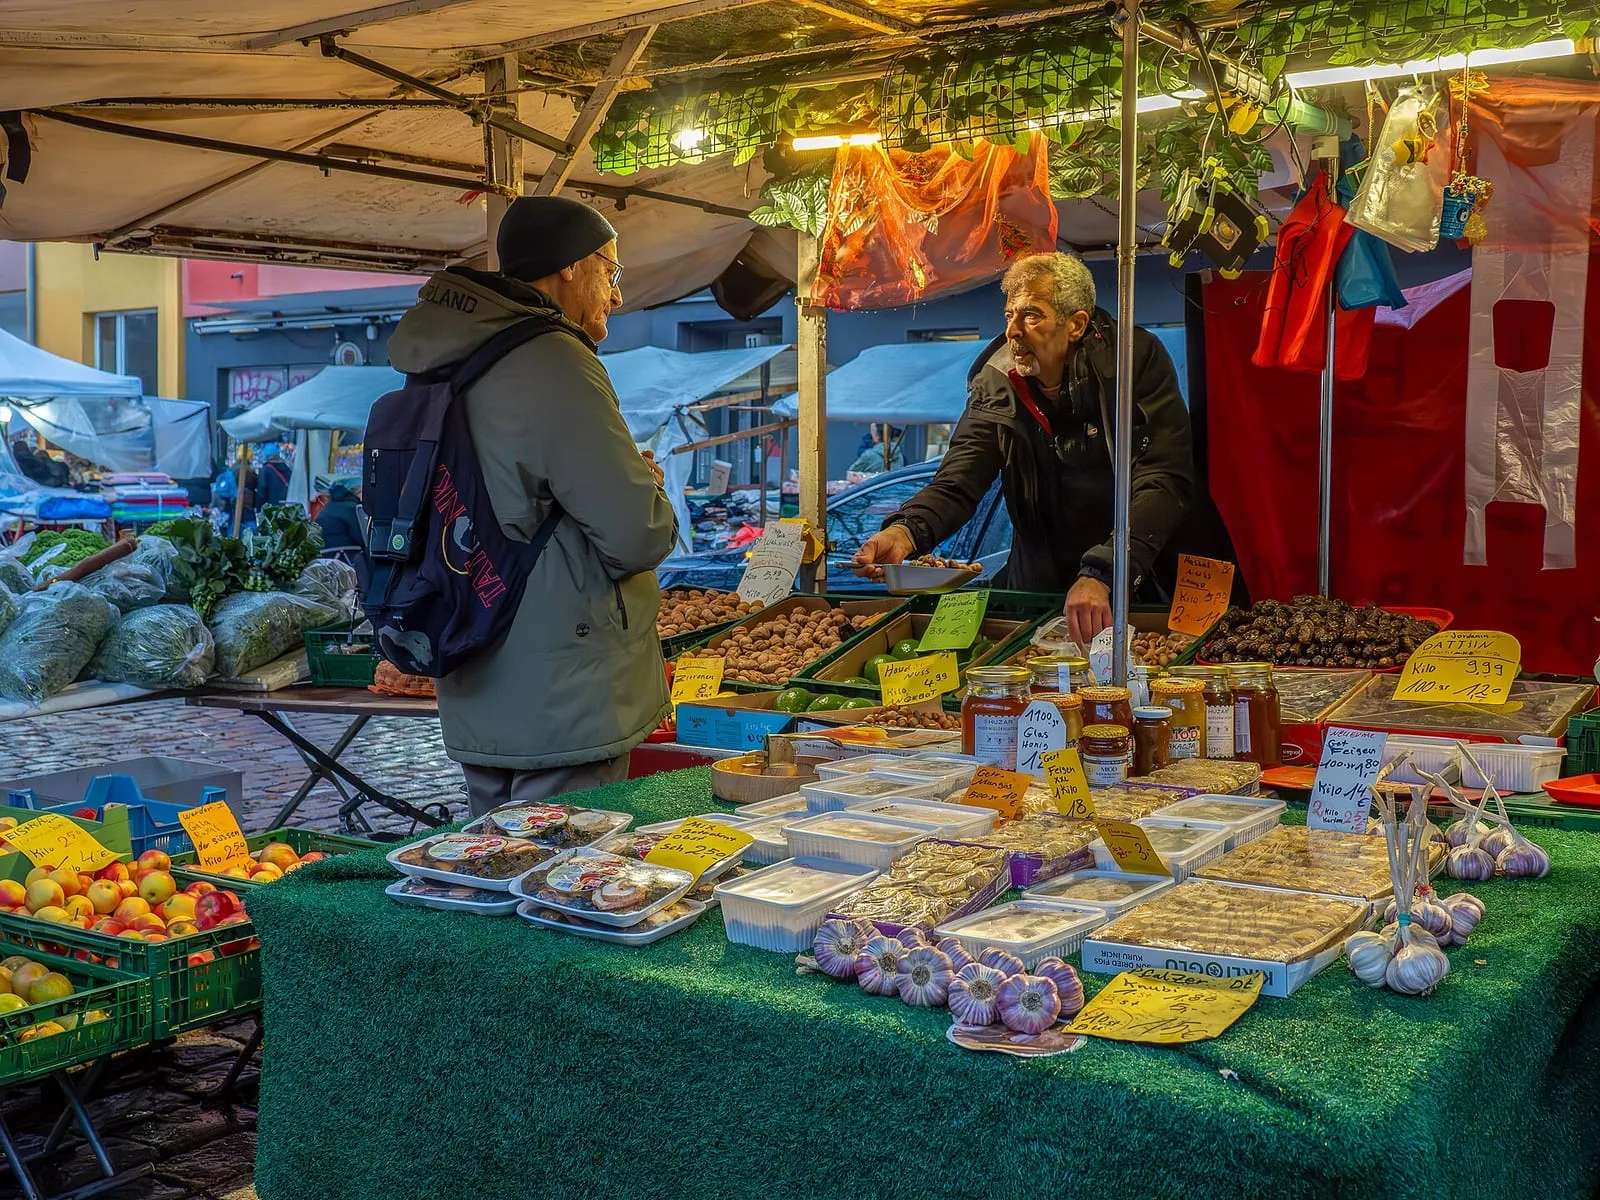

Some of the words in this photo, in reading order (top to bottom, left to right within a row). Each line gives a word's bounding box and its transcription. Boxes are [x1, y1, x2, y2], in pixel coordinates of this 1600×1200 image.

[1411, 661, 1437, 675] Kilo
[1023, 726, 1049, 739] Glas
[1060, 784, 1078, 796] Kilo
[1318, 780, 1342, 796] Kilo
[1065, 798, 1087, 817] 18
[203, 856, 222, 867] Kilo
[1093, 957, 1110, 966] FIGS
[1122, 953, 1143, 962] KURU
[1111, 960, 1134, 969] DRIED
